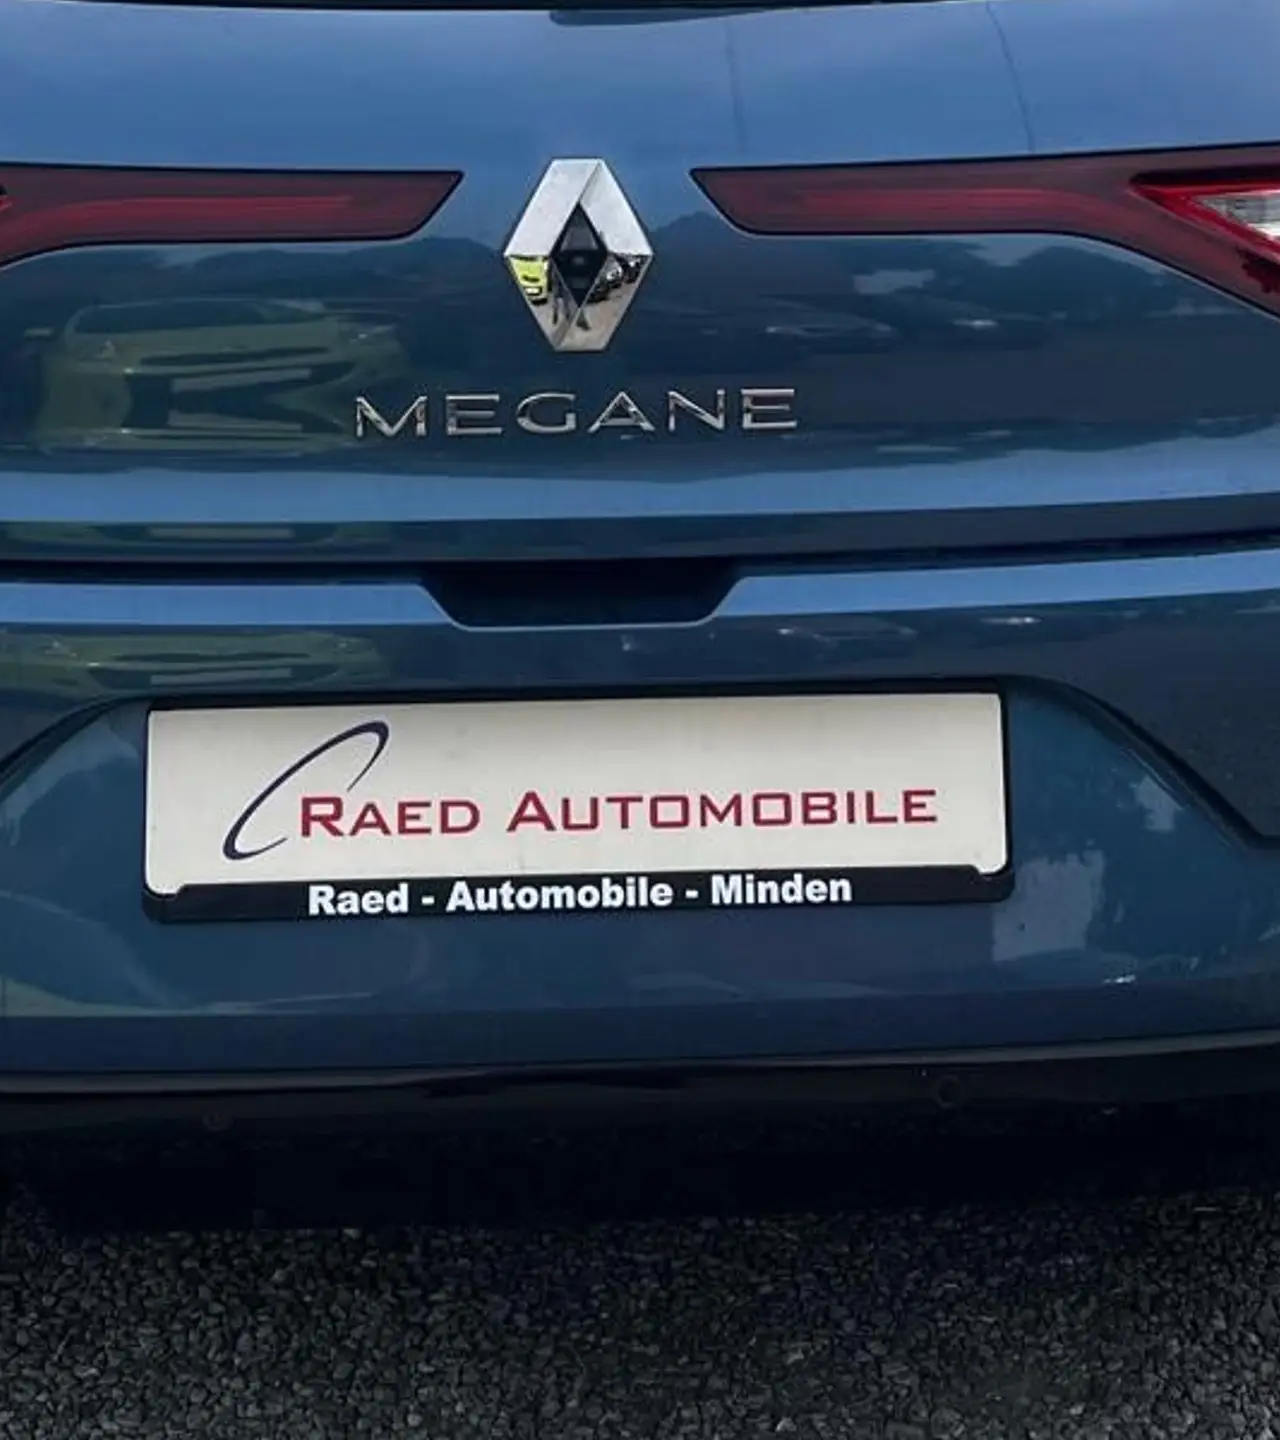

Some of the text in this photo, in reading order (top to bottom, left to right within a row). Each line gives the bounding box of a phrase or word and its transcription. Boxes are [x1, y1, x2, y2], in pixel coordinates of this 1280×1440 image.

[355, 388, 798, 437] MEGANE
[299, 788, 938, 838] RAED AUTOMOBILE
[308, 883, 410, 917] Raed
[446, 877, 674, 912] Automobile
[710, 874, 853, 907] Minden
